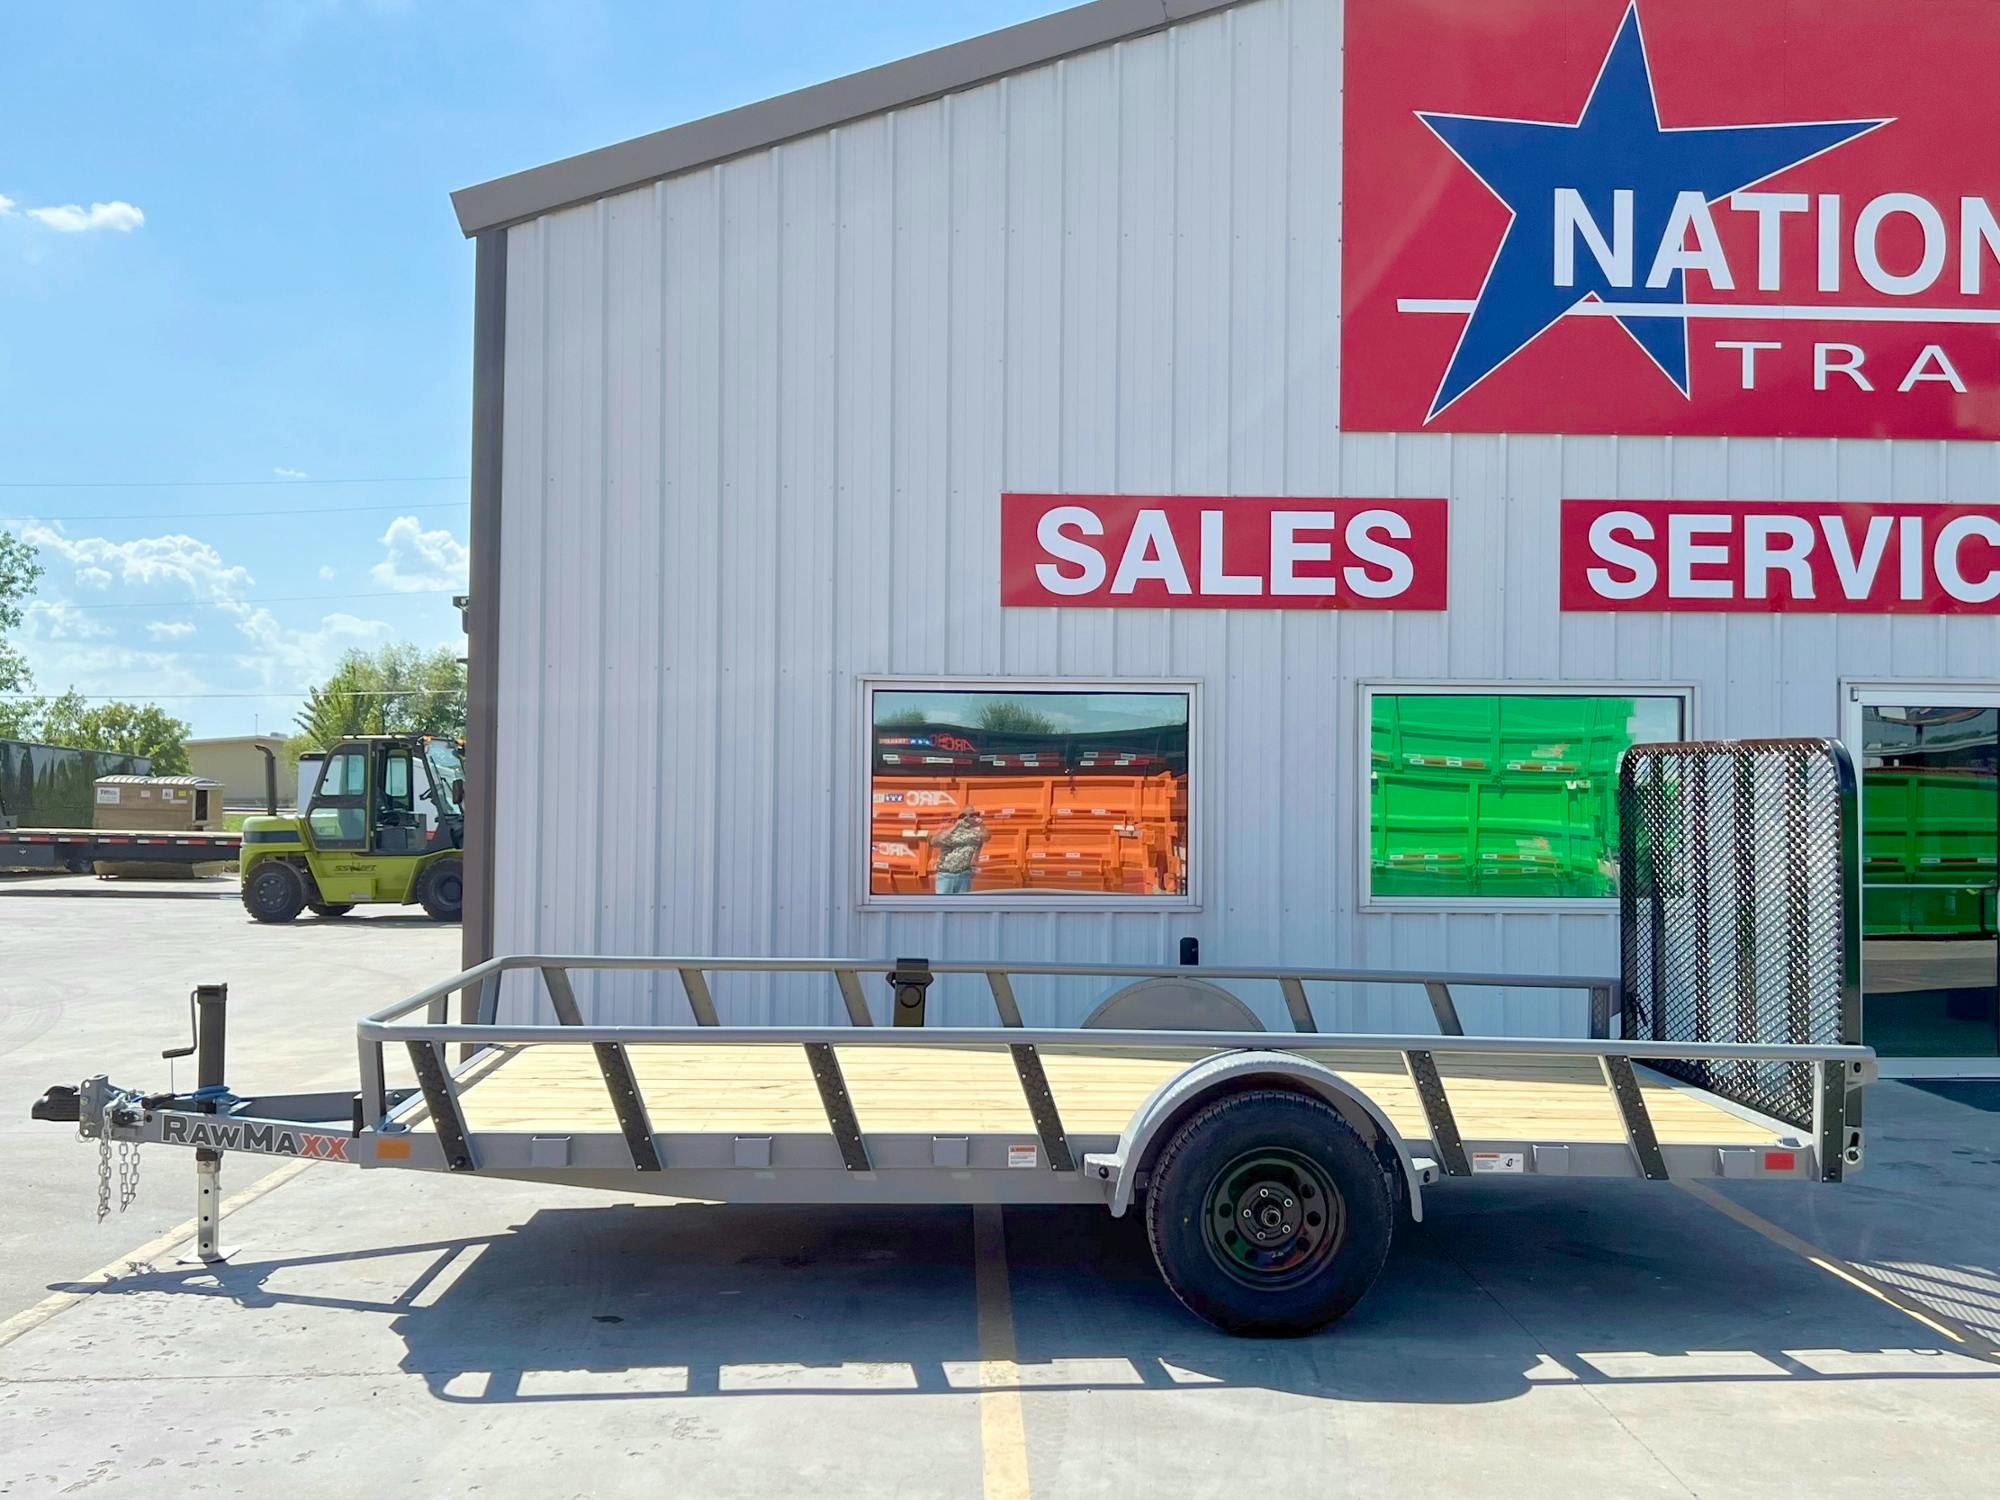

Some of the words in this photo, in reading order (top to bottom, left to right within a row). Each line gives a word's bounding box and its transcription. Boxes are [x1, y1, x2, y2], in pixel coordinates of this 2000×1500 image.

[1714, 341, 1968, 393] TRA
[1034, 506, 1415, 599] SALES
[1586, 510, 2000, 604] SERVIC
